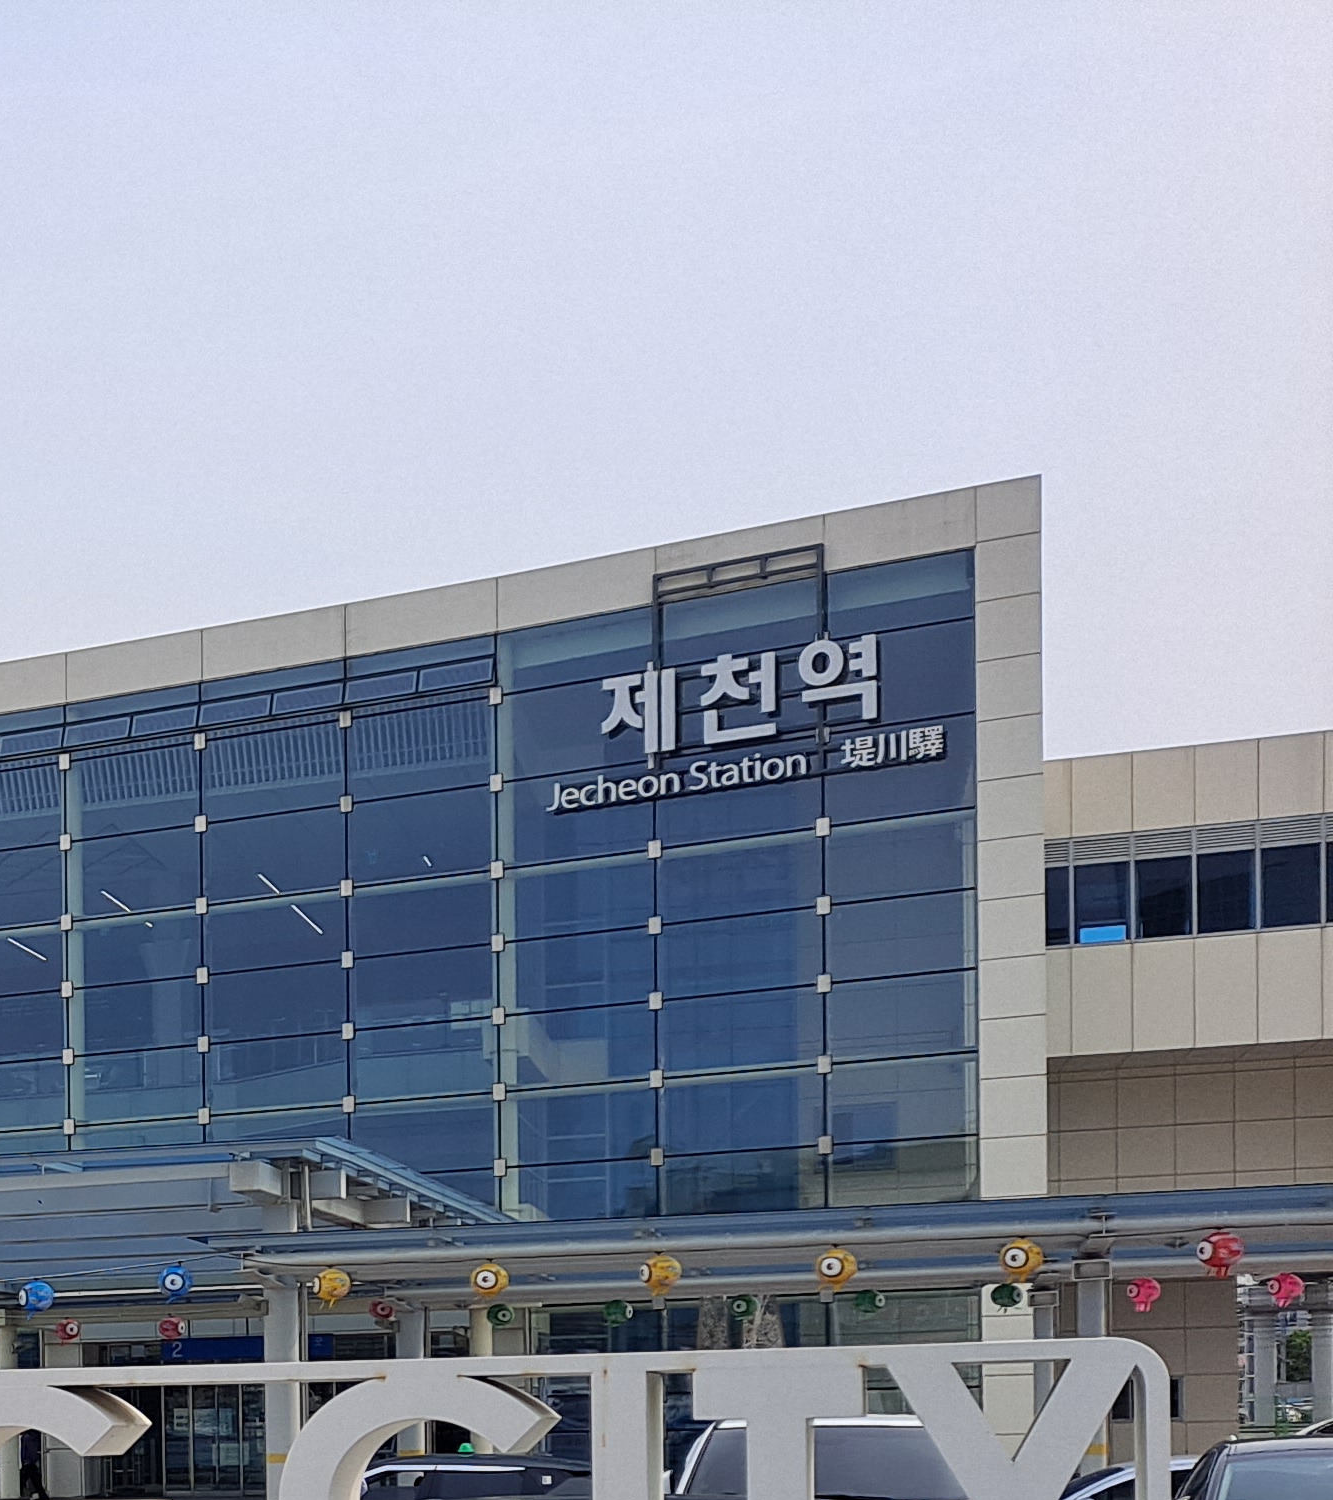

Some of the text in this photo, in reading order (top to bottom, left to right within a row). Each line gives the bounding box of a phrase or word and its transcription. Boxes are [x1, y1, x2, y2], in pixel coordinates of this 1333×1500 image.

[601, 633, 879, 754] 제천역
[840, 725, 945, 768] 堤川驛
[545, 751, 808, 813] Jecheon Station
[171, 1341, 183, 1358] 2
